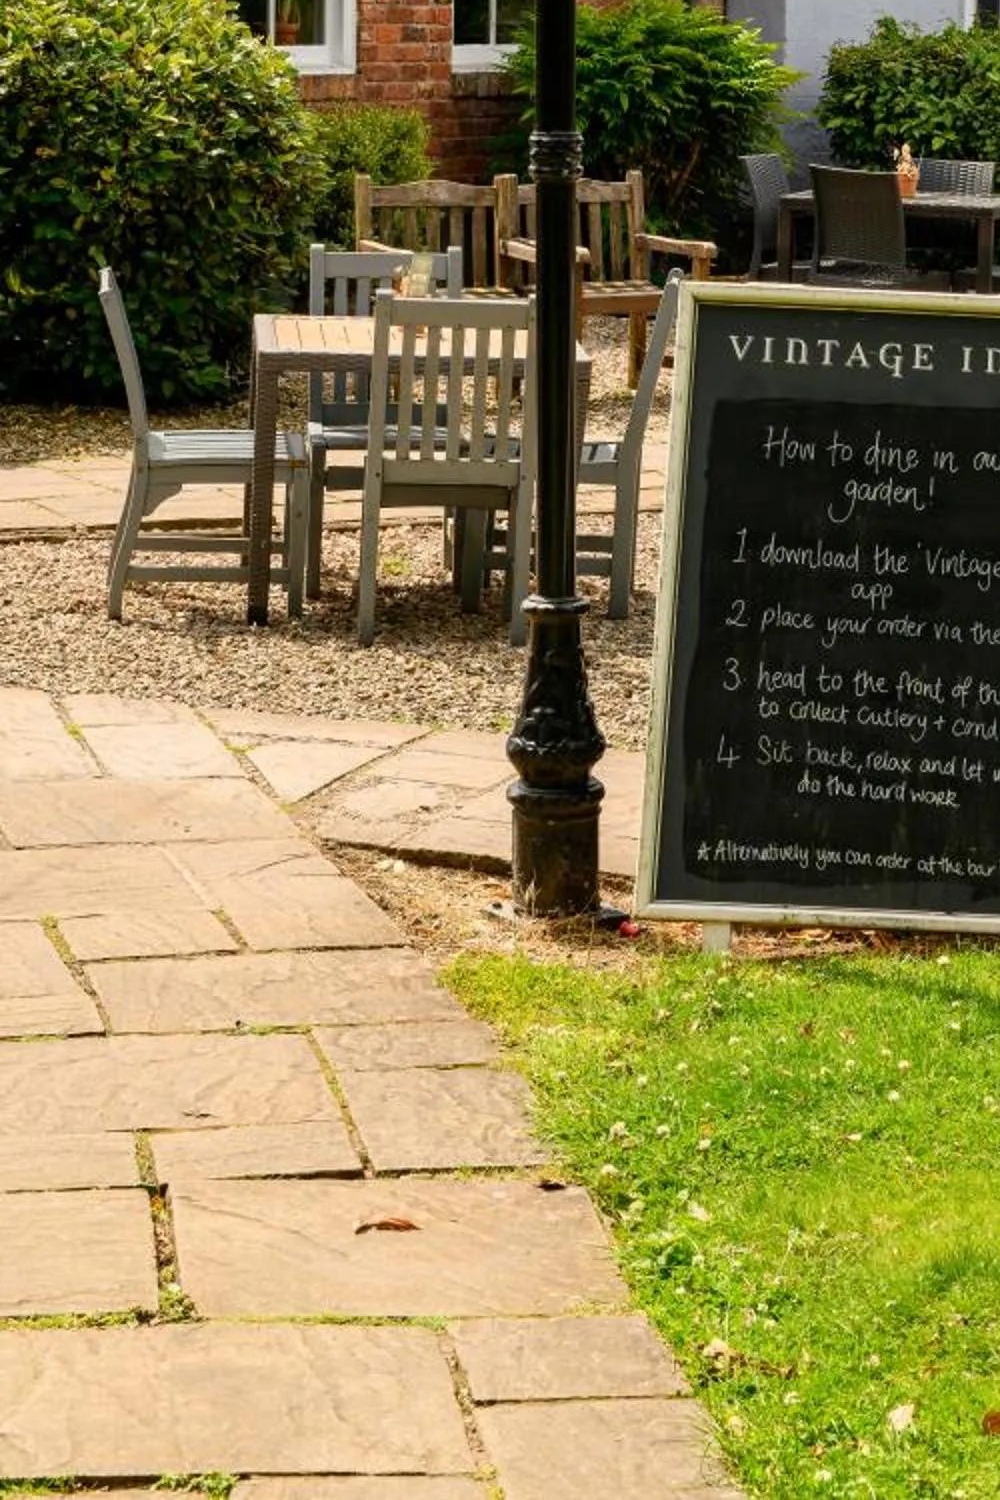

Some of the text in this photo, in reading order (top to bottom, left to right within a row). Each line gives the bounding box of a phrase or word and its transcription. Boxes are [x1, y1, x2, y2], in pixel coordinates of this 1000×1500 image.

[729, 335, 935, 377] VINTAGE
[763, 424, 815, 468] How
[826, 429, 852, 467] to
[864, 429, 919, 475] dine
[933, 443, 958, 473] in
[828, 476, 935, 523] garden!
[732, 527, 748, 564] 1
[760, 532, 859, 573] download
[873, 544, 909, 575] the
[851, 583, 893, 611] app
[725, 599, 749, 627] 2
[760, 601, 816, 634] place
[821, 616, 873, 649] your
[877, 614, 926, 637] order
[933, 621, 963, 643] via
[757, 661, 807, 697] head
[817, 663, 843, 693] to
[852, 668, 889, 697] the
[895, 670, 945, 704] front
[951, 675, 973, 709] of
[757, 696, 780, 719] to
[788, 701, 850, 725] collect
[716, 733, 741, 769] 4
[756, 735, 793, 766] Sit
[866, 749, 913, 773] relax
[919, 755, 957, 777] and
[961, 757, 985, 782] let
[797, 768, 961, 808] do the hard work
[815, 849, 842, 871] you
[845, 849, 873, 867] can
[875, 852, 913, 869] order
[917, 855, 936, 876] at
[936, 856, 966, 876] the
